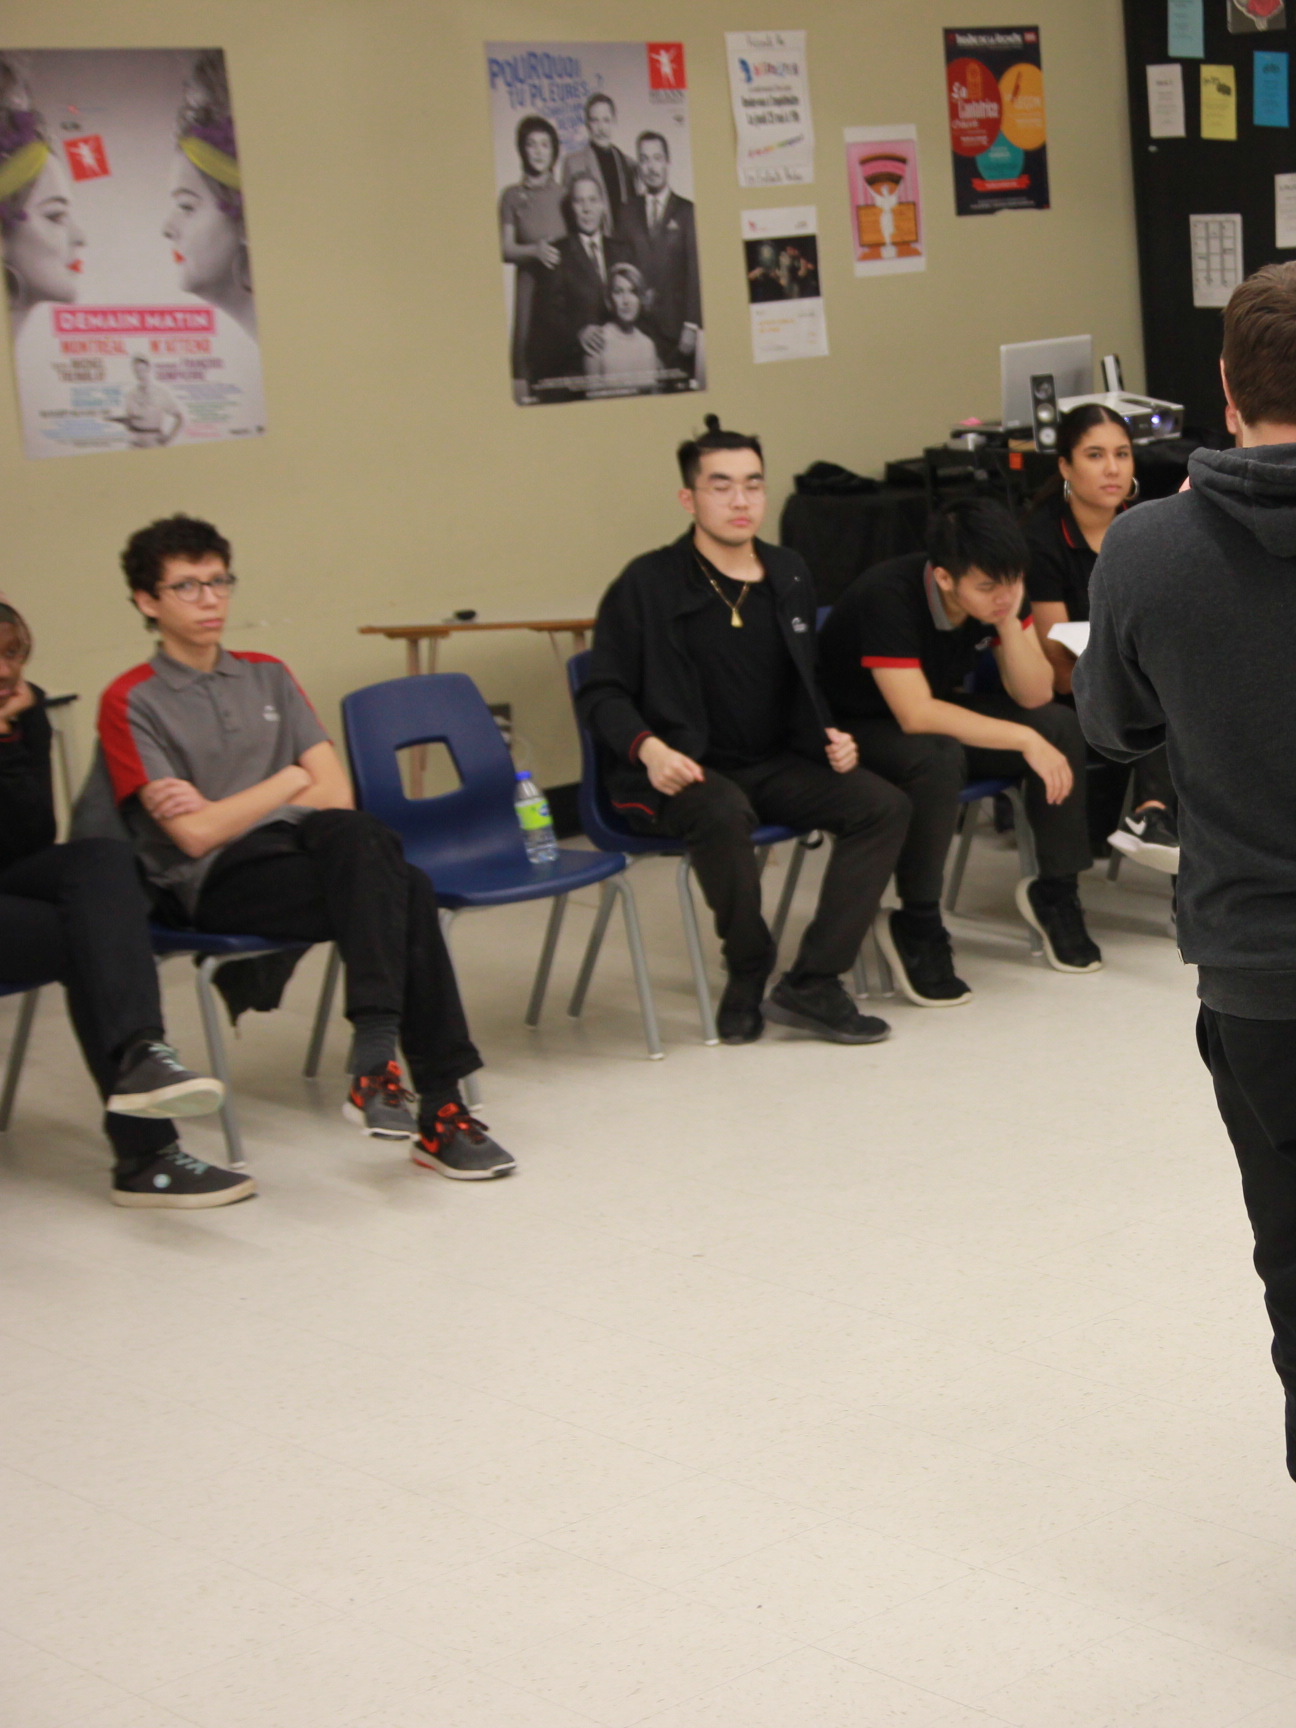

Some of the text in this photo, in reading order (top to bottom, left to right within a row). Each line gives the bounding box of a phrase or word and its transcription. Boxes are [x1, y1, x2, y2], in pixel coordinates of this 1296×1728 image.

[488, 51, 581, 90] POURQUOI
[59, 311, 210, 330] DEMAIN MATIN
